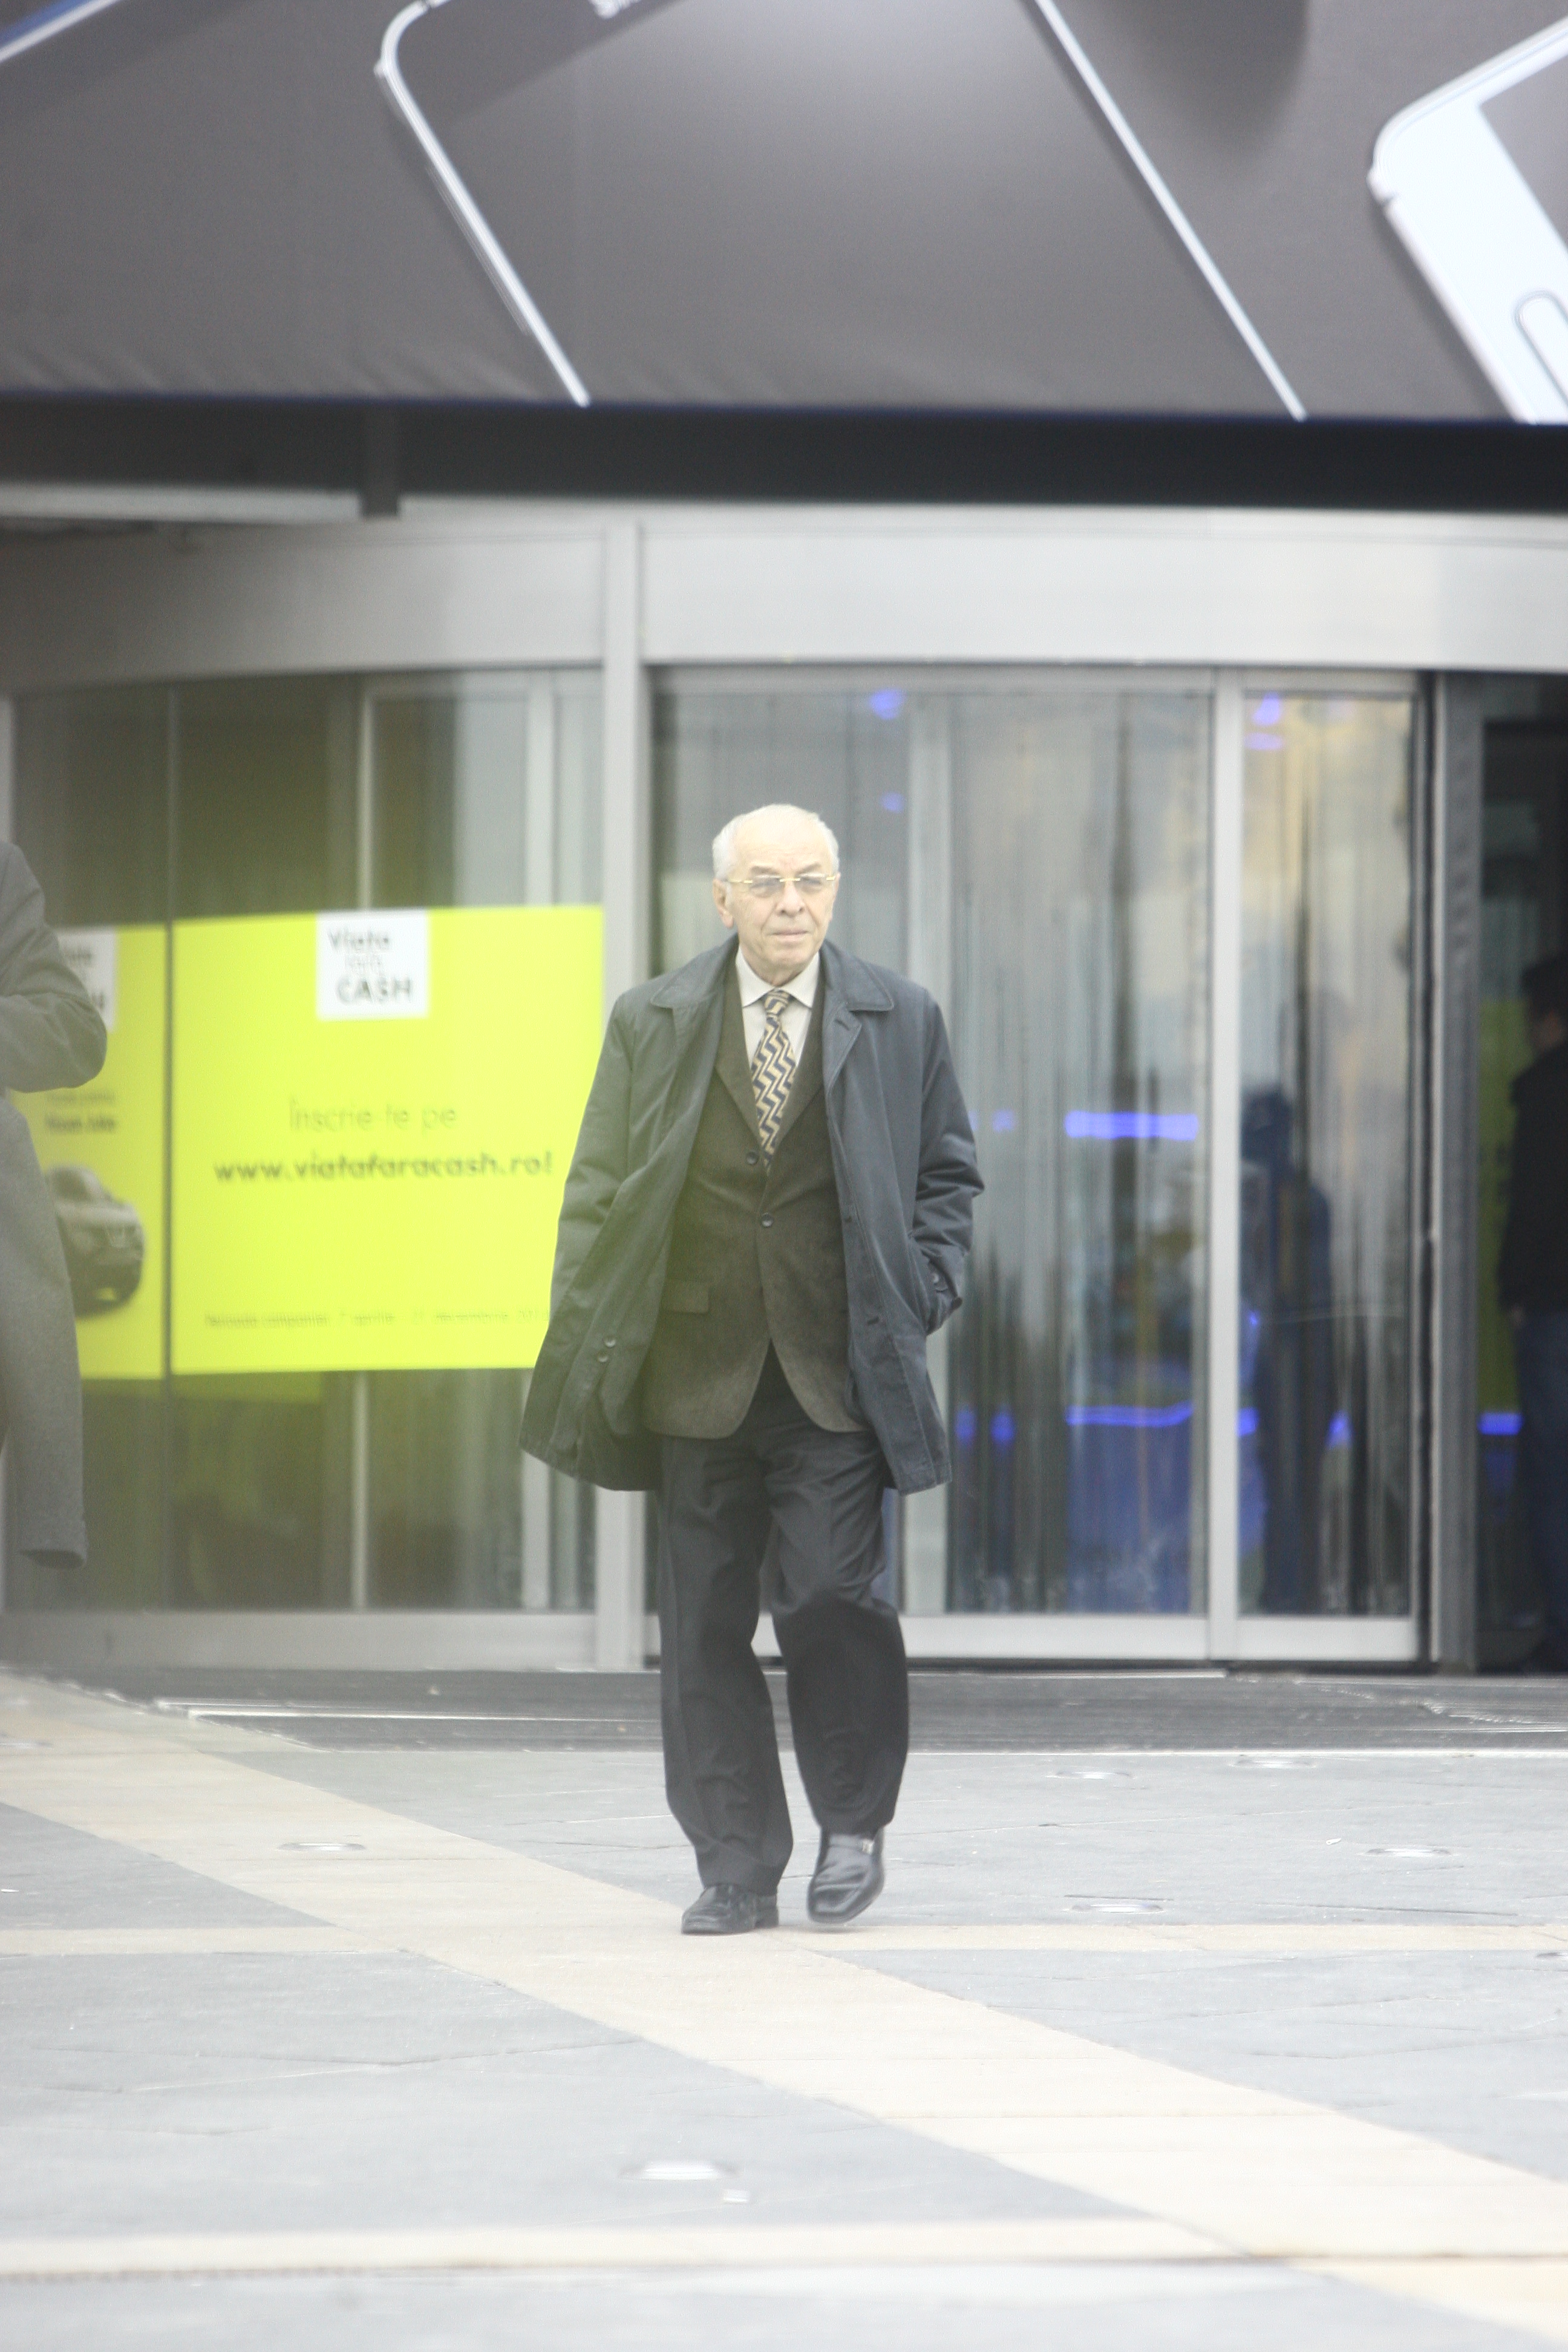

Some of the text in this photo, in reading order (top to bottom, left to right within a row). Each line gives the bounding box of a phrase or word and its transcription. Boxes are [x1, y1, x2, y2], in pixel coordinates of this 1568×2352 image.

[336, 975, 413, 1004] CASH
[421, 1106, 457, 1138] pe
[214, 1149, 553, 1181] www.viatafaracash.ro!
